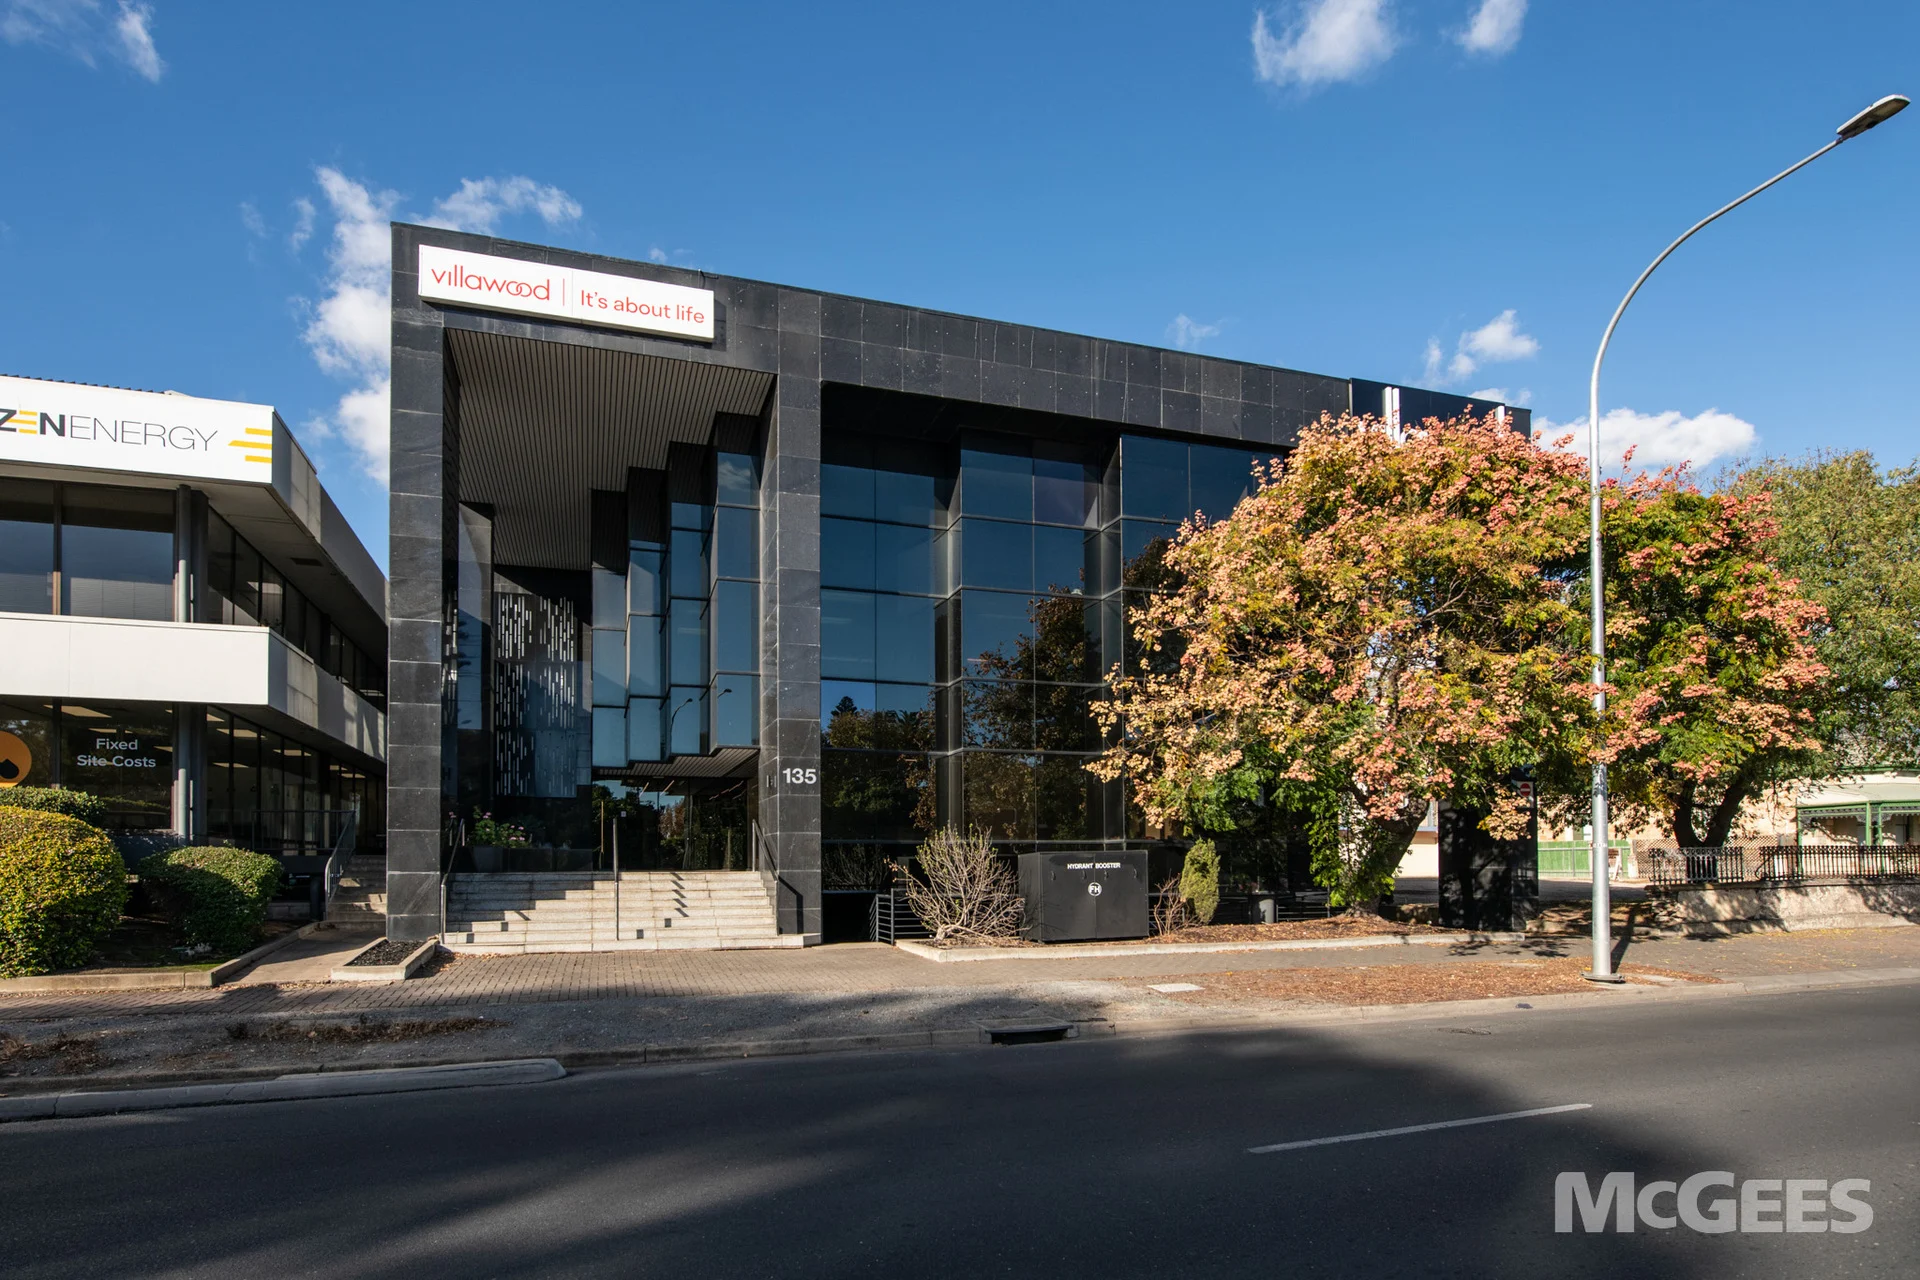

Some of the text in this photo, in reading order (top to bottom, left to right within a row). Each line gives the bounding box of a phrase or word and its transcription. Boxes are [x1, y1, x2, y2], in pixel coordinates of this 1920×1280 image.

[431, 264, 550, 301] villawood
[581, 289, 705, 324] It's about life
[96, 738, 138, 750] Fixed
[77, 755, 156, 768] Site Costs
[782, 767, 817, 785] 135
[1067, 862, 1094, 870] HYDRANT
